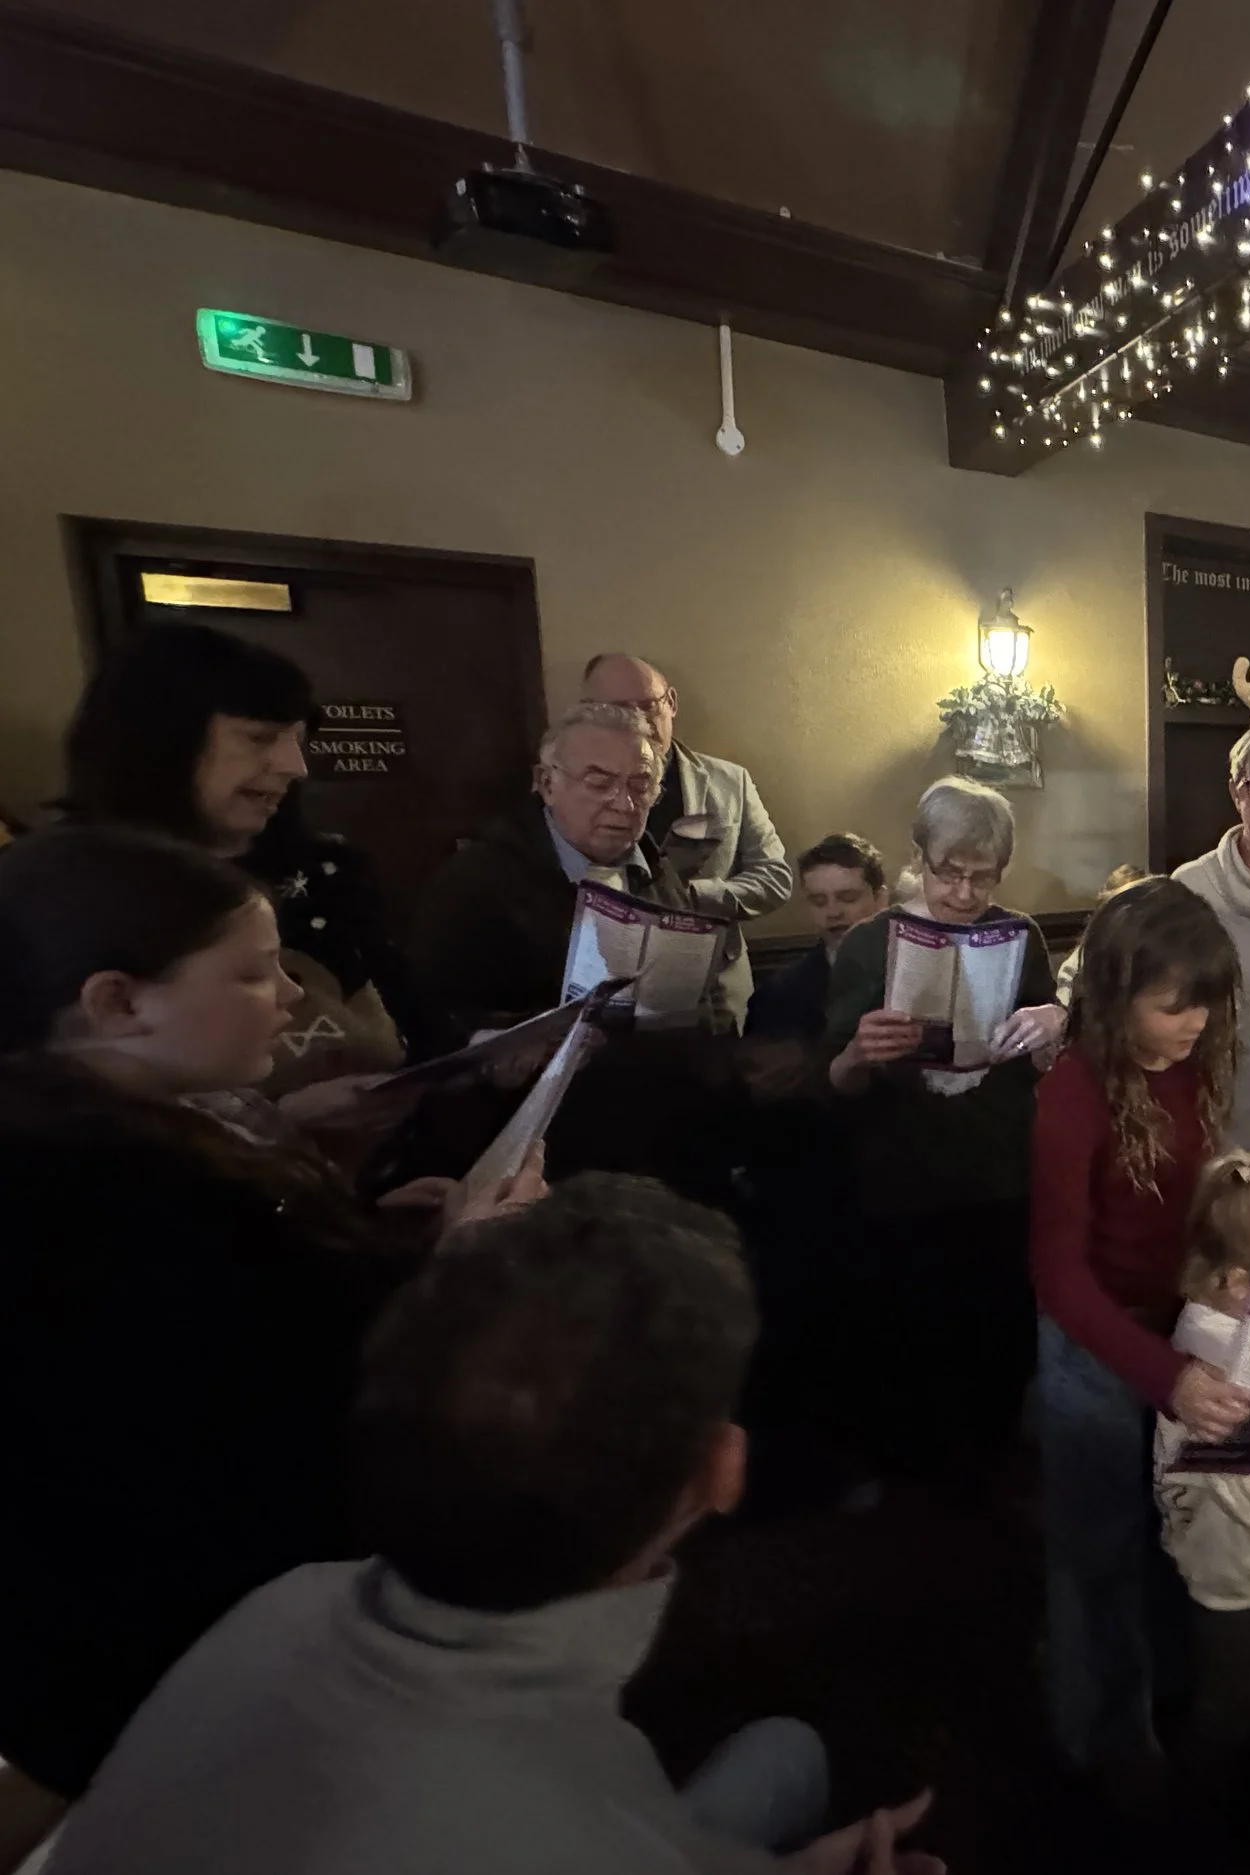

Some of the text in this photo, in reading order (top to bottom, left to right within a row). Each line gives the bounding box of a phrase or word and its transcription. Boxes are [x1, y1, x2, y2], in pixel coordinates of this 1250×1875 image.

[1161, 561, 1190, 586] The
[1194, 569, 1232, 589] most
[308, 741, 406, 755] SMOKING
[334, 758, 389, 773] AREA
